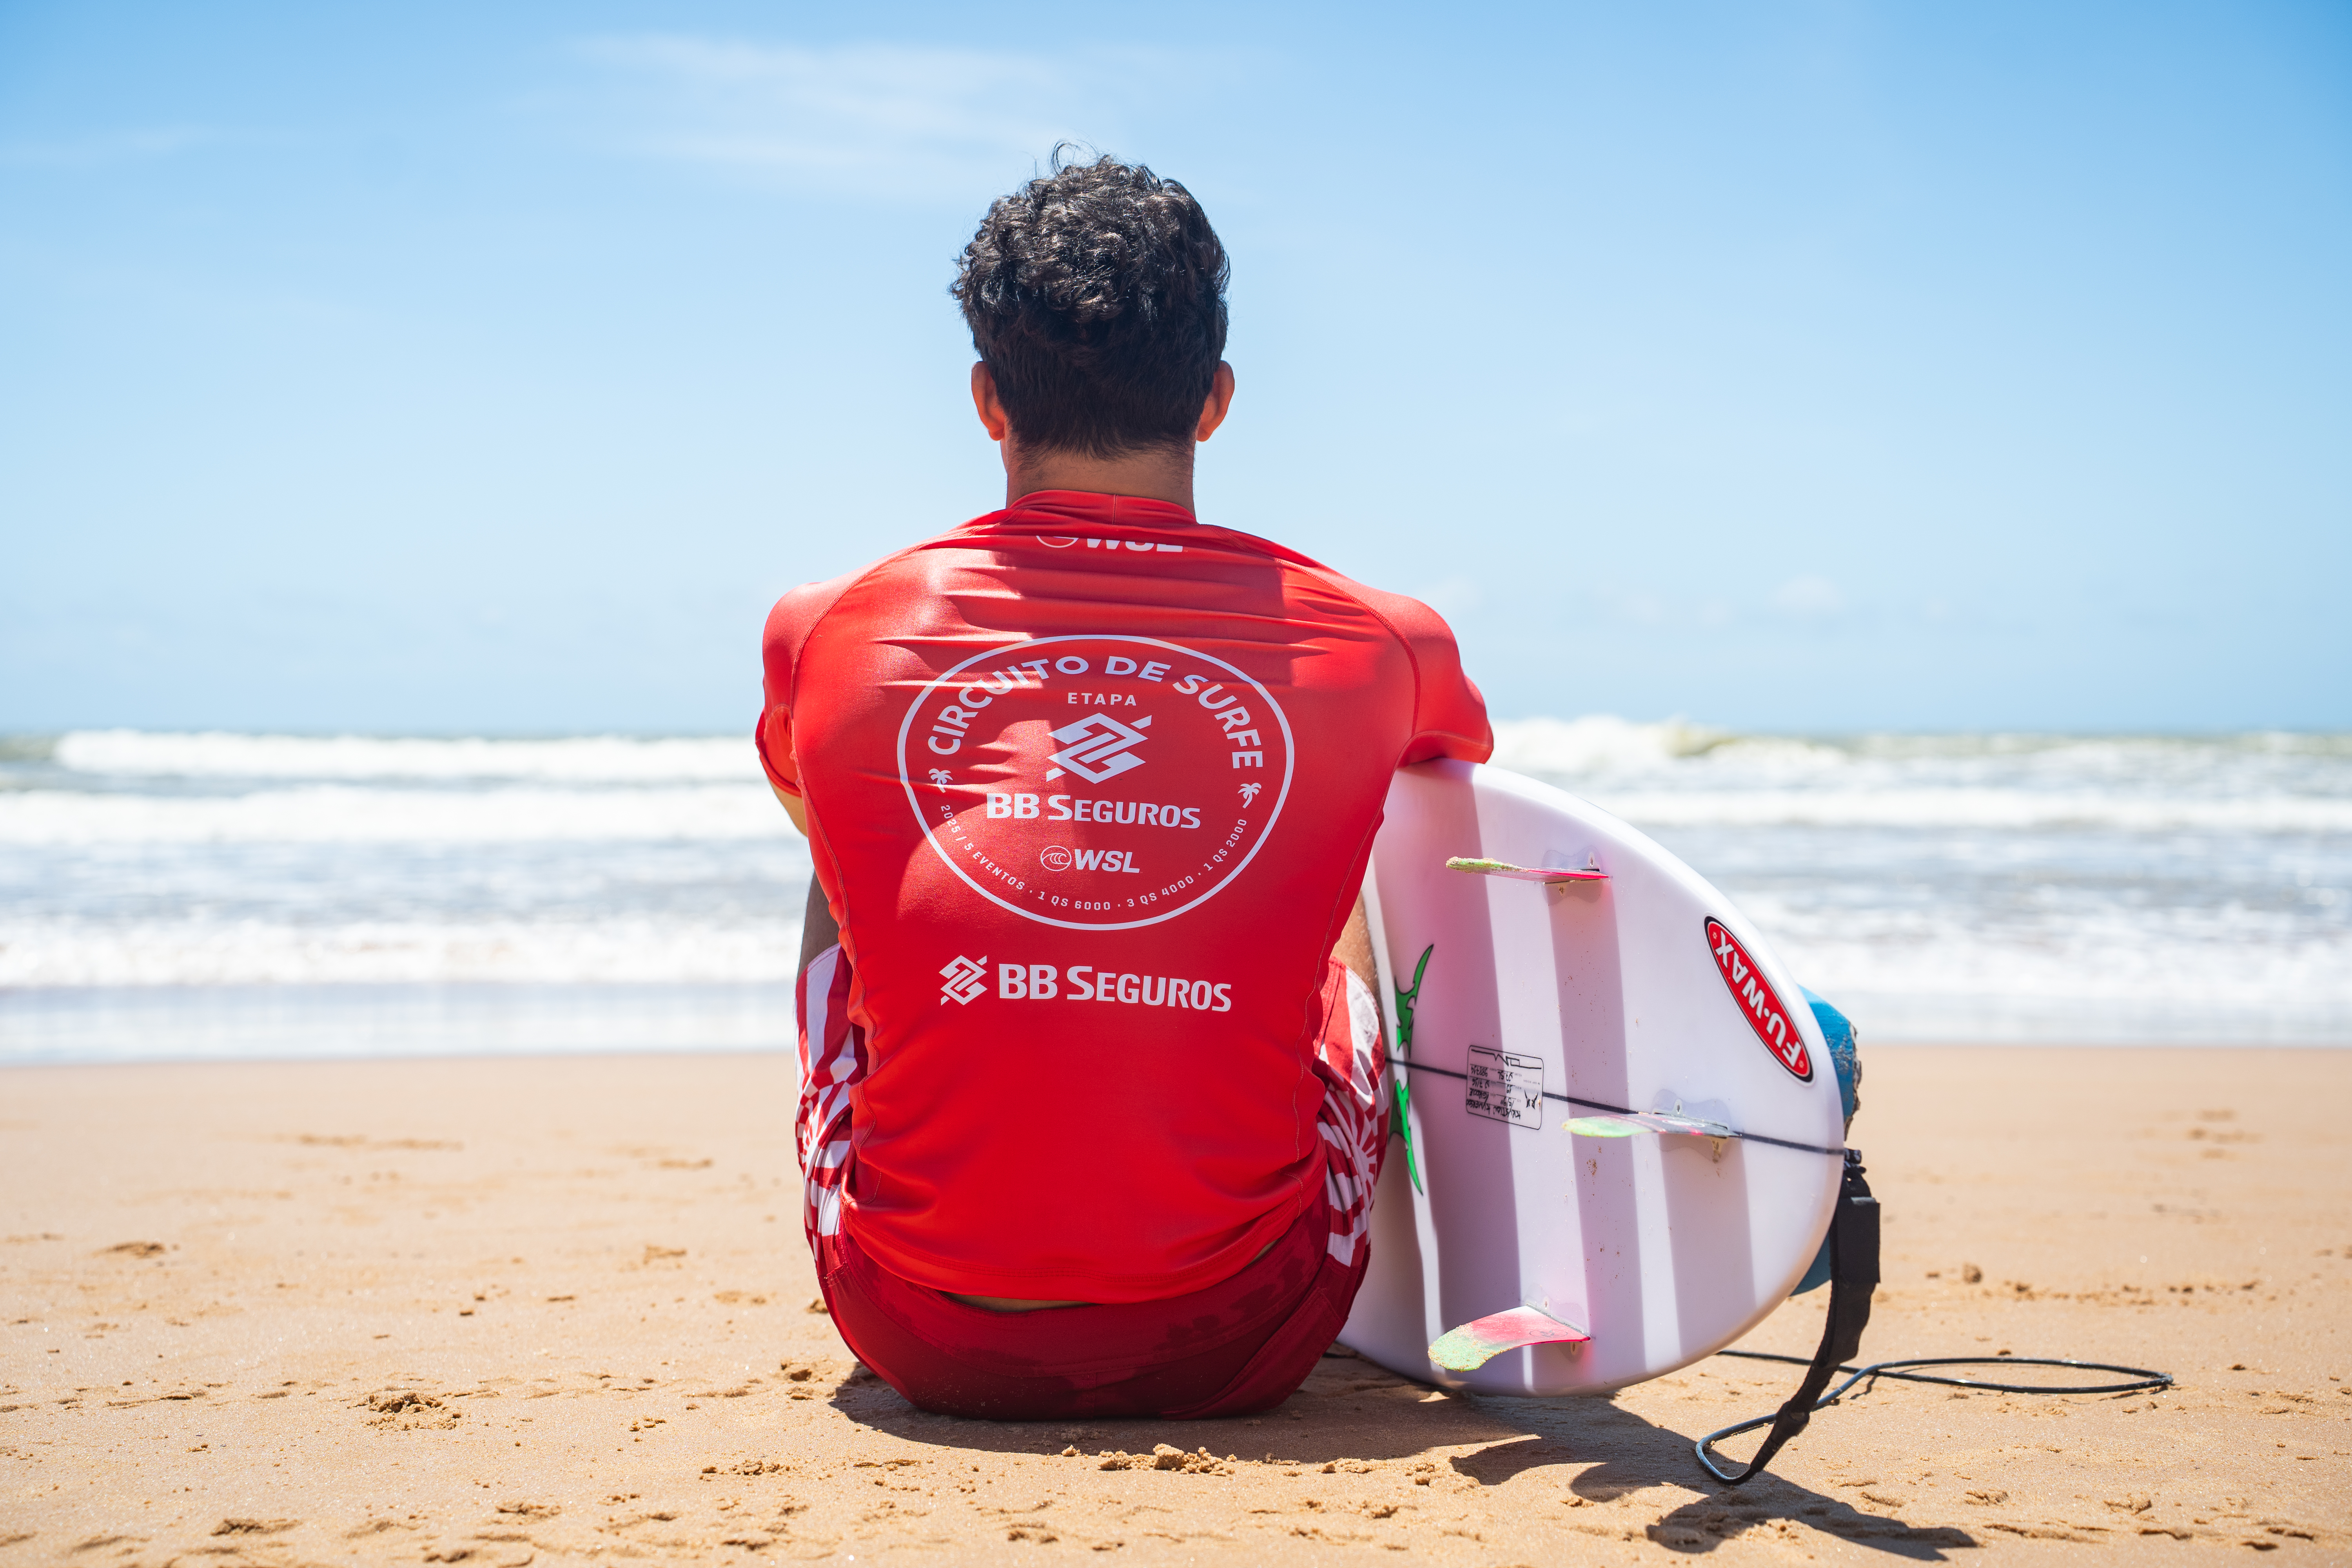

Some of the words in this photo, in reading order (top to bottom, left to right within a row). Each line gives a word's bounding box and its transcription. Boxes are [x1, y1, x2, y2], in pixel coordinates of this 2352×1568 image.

[928, 656, 1089, 755] CIRCUITO
[1105, 656, 1172, 682] DE
[1172, 675, 1263, 769] SURFE
[1068, 692, 1136, 706] ETAPA
[986, 793, 1040, 819] BB
[1047, 795, 1201, 829] SEGUROS
[941, 805, 961, 833] 2025
[964, 842, 974, 851] 5
[973, 851, 1025, 890] EVENTOS
[1038, 891, 1045, 900] 1
[1051, 896, 1069, 906] QS
[1074, 901, 1111, 910] 6000
[1127, 898, 1134, 907] 3
[1140, 893, 1157, 905] QS
[1161, 876, 1194, 895] 4000
[1203, 863, 1213, 871] 1
[1213, 849, 1228, 862] QS
[1226, 819, 1247, 848] 2000
[1074, 849, 1140, 873] WSL
[999, 964, 1058, 999] BB
[1067, 965, 1231, 1012] SEGUROS
